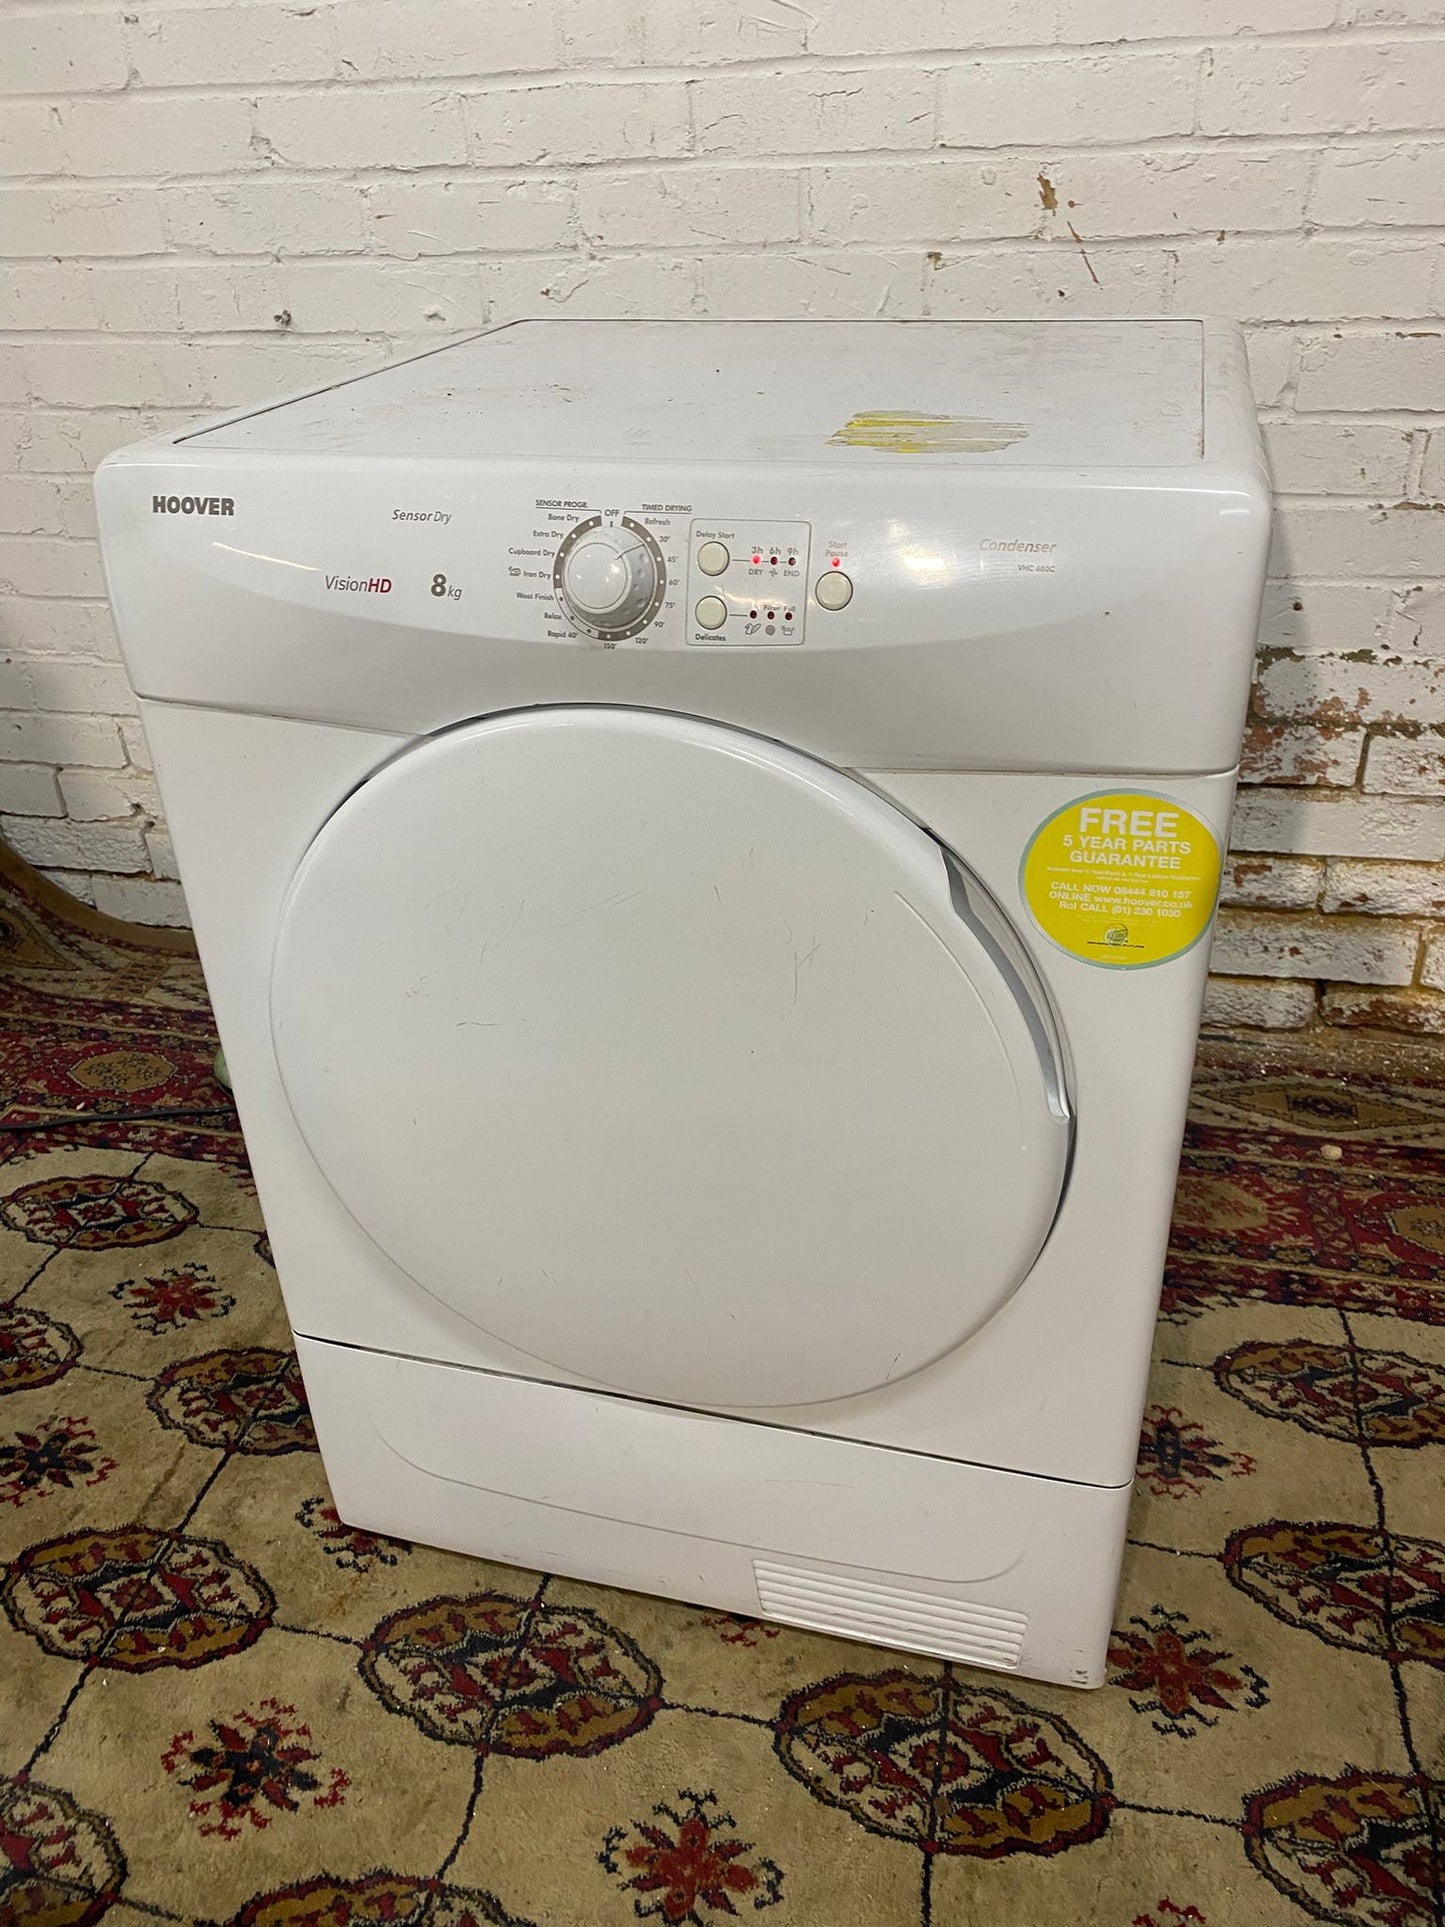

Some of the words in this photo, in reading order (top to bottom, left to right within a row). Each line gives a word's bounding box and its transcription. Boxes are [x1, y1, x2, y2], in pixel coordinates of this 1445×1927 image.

[152, 495, 236, 516] HOOVER
[535, 499, 562, 507] SENSOR
[642, 504, 664, 512] TIMED
[665, 504, 693, 512] DRYING
[604, 509, 620, 517] OFF
[548, 513, 565, 521] Bone
[566, 514, 580, 523] Dry
[644, 517, 671, 526] Refresh
[532, 530, 550, 538] Extra
[551, 530, 564, 540] Dry
[696, 530, 716, 540] Delay
[717, 531, 735, 540] Start
[828, 541, 848, 549] Start
[980, 538, 1057, 553] Condenser
[508, 547, 541, 557] Cupboard
[542, 549, 556, 559] Dry
[751, 546, 764, 555] 3h
[769, 546, 782, 555] 6h
[787, 546, 800, 555] 9h
[825, 550, 849, 558] Pause
[538, 571, 552, 580] Dry
[783, 570, 800, 578] END
[324, 574, 393, 594] VisionHD
[516, 592, 533, 600] Wool
[534, 593, 555, 601] Finish
[544, 612, 562, 620] Relax
[548, 630, 566, 640] Rapid
[694, 633, 727, 642] Delicates
[1079, 807, 1180, 838] FREE
[1063, 834, 1074, 848] 5
[1078, 835, 1127, 851] YEAR
[1132, 839, 1192, 855] PARTS
[1069, 850, 1182, 870] GUARANTEE
[1051, 882, 1080, 892] CALL
[1082, 884, 1111, 894] NOW
[1048, 891, 1091, 903] ONLINE
[1094, 895, 1194, 910] www.hoover.co.uk
[1080, 902, 1109, 913] CALL
[1112, 905, 1132, 916] (01)
